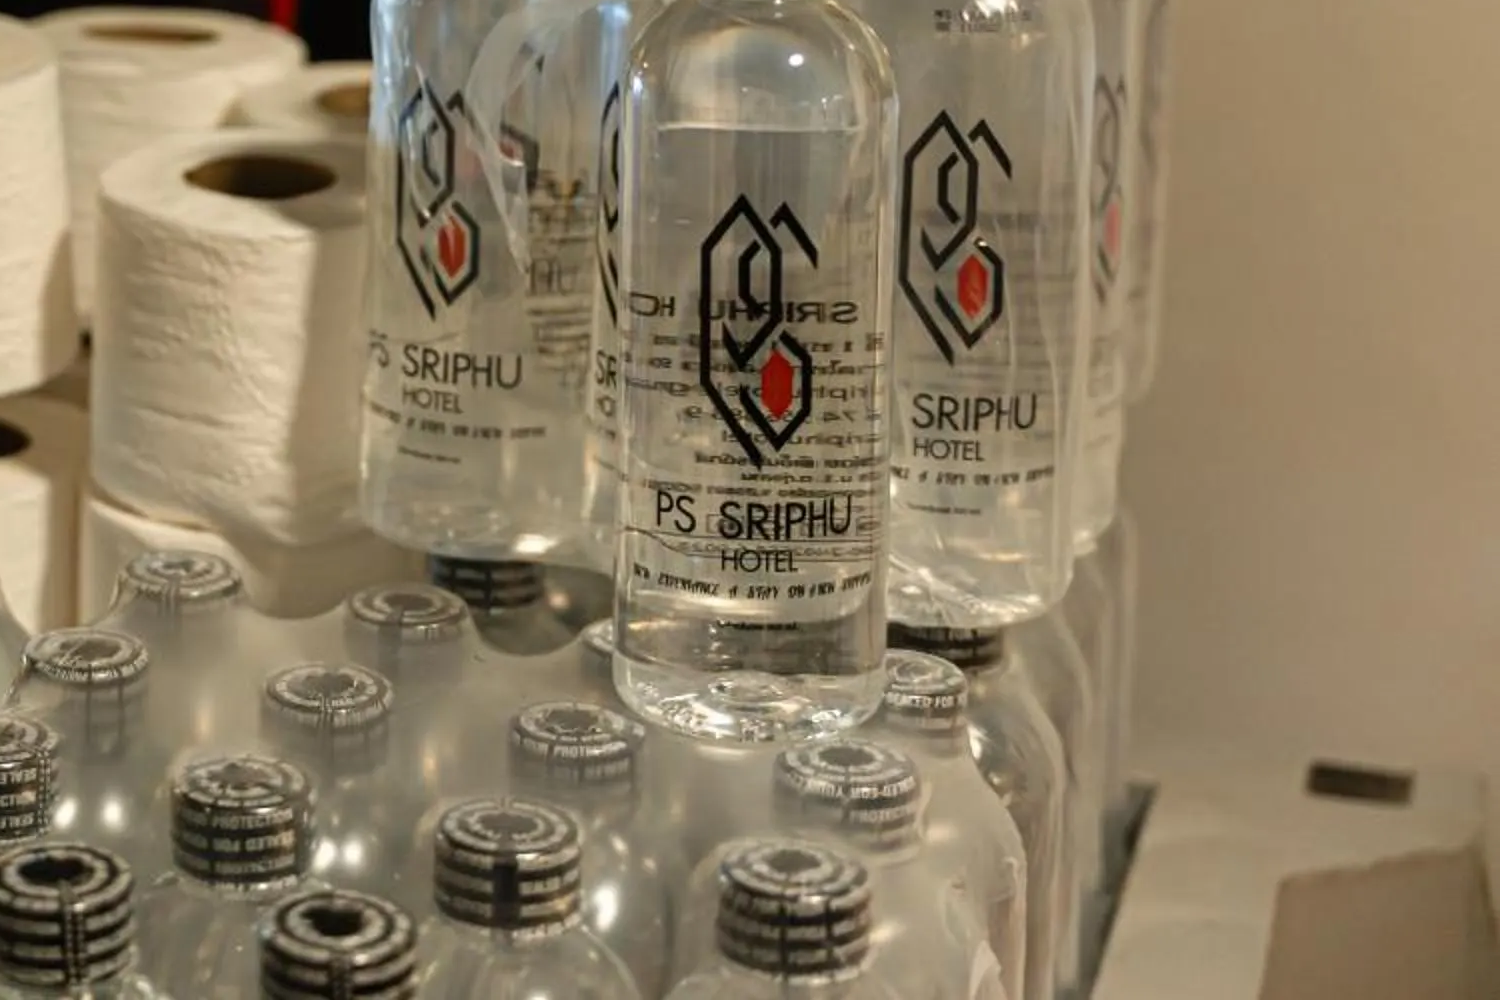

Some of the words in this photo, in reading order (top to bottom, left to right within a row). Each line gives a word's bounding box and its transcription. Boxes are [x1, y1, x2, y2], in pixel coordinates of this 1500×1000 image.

[402, 343, 522, 390] SRIPHU
[402, 384, 464, 414] HOTEL
[911, 392, 1037, 432] SRIPHU
[913, 437, 985, 461] HOTEL
[656, 490, 697, 533] PS
[719, 494, 852, 540] SRIPHU
[721, 549, 799, 573] HOTEL
